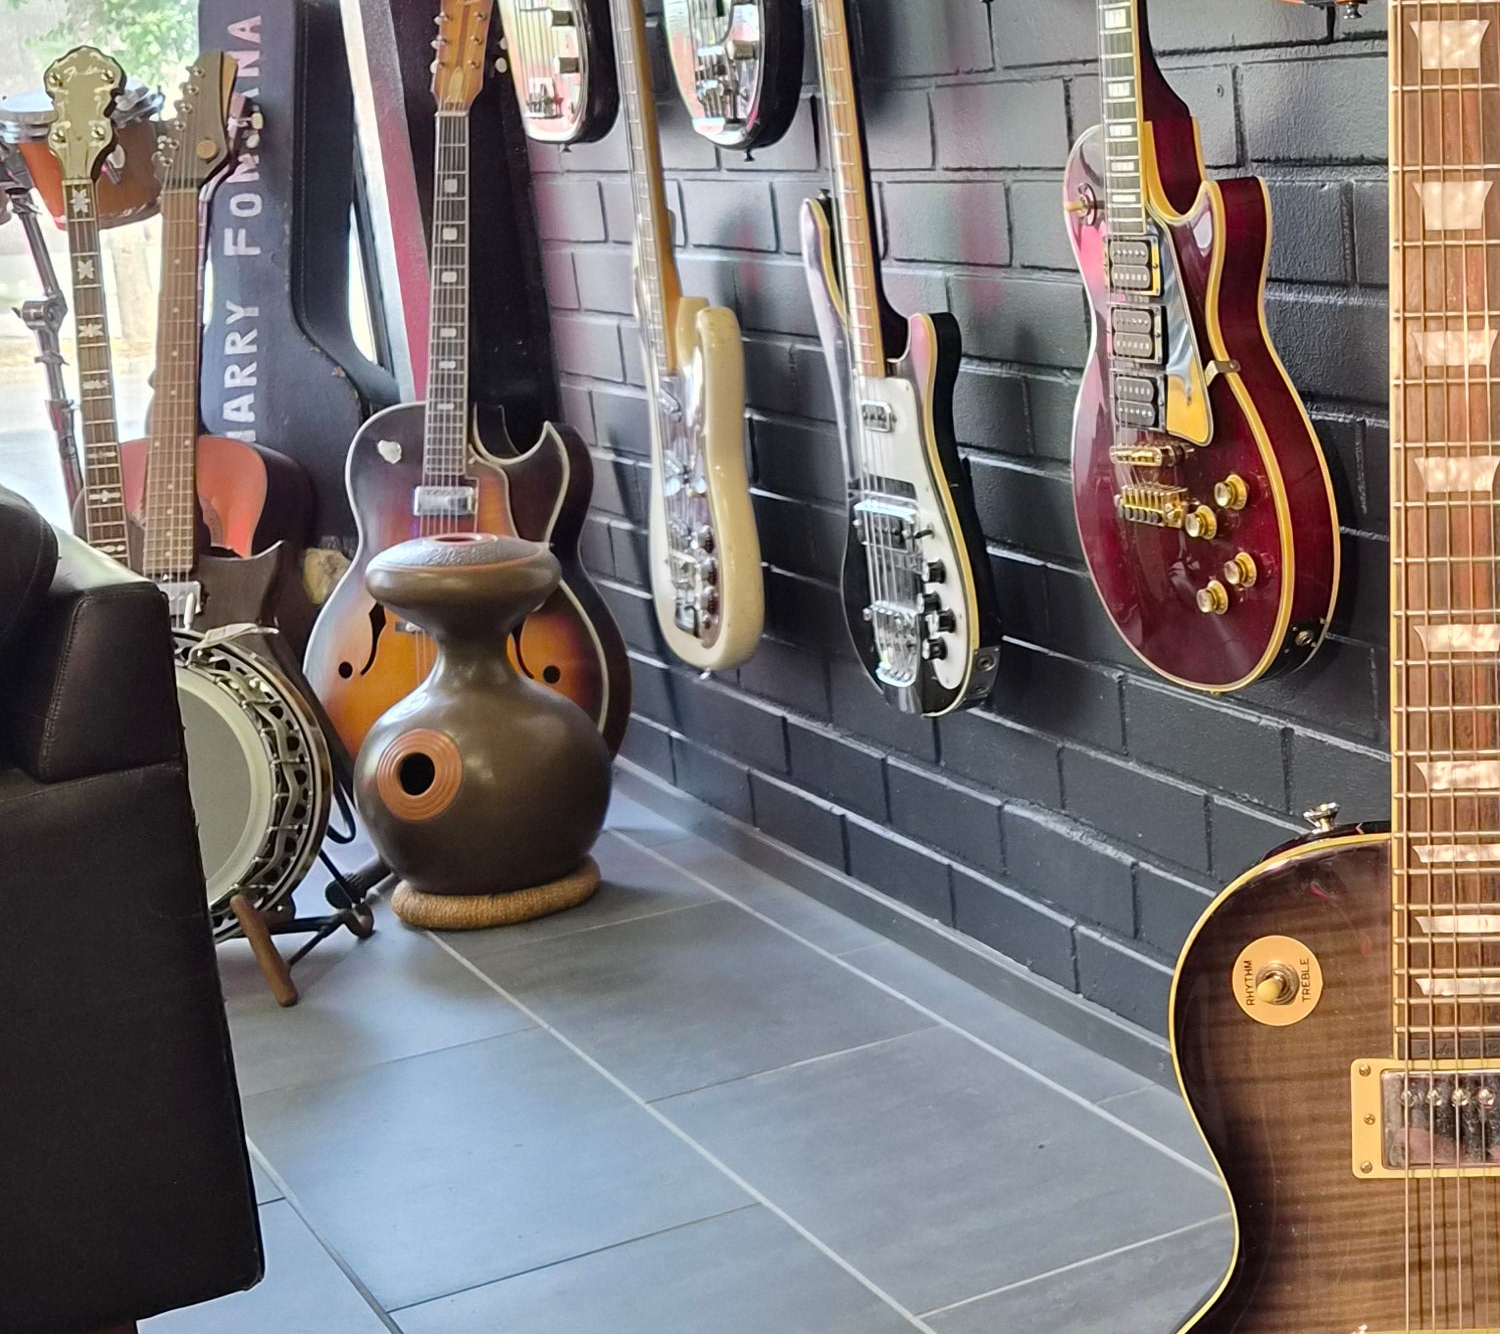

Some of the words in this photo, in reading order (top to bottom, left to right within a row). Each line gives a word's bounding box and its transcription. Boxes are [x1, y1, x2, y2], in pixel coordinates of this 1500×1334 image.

[223, 14, 263, 257] FONNA
[1243, 960, 1256, 1006] RHYTHM
[1299, 958, 1311, 1003] TREBLE
